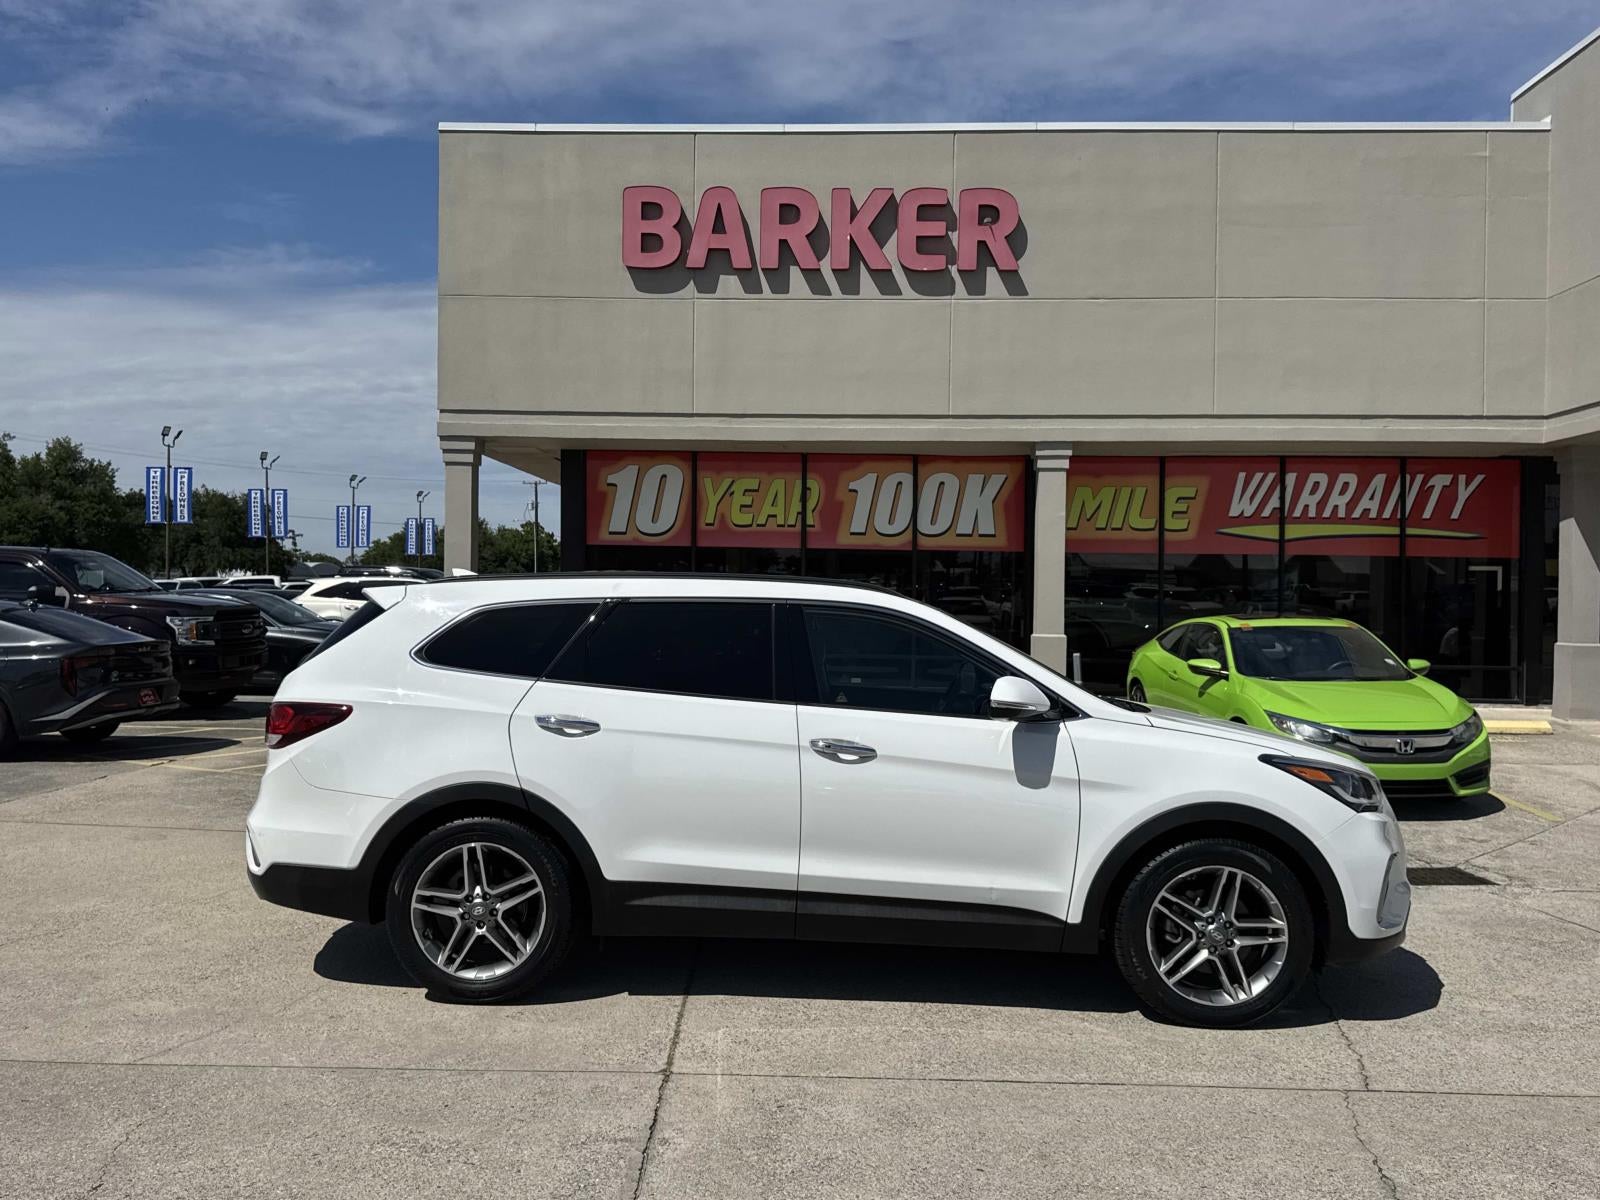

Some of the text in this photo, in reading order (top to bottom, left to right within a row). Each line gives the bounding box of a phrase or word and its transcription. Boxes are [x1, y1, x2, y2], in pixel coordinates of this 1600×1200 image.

[622, 185, 1020, 271] BARKER
[151, 470, 160, 520] TERREBONNE
[178, 474, 187, 520] PREOWNED
[606, 464, 1487, 537] 10 YEAR 100K MILE WARRANTY
